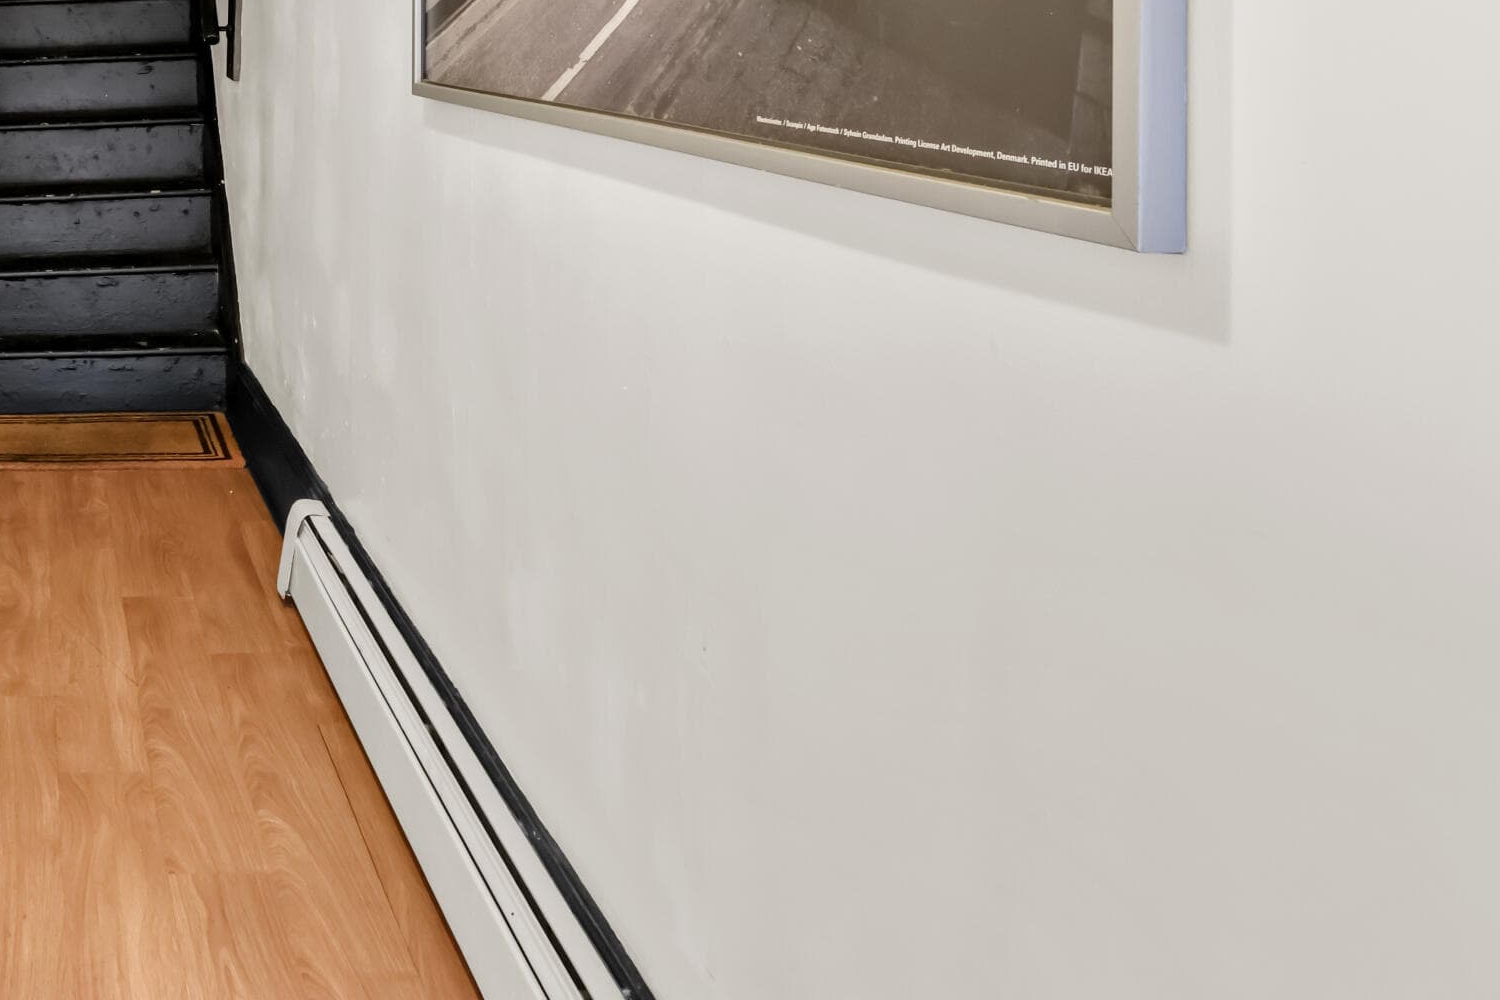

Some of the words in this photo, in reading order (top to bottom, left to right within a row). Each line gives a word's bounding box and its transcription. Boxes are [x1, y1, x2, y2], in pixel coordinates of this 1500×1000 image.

[894, 136, 917, 148] Printing
[917, 139, 940, 150] License
[940, 143, 951, 152] Art
[951, 145, 996, 160] Development,
[1031, 156, 1058, 168] Printed
[1058, 160, 1067, 169] in
[1067, 161, 1080, 171] EU
[1080, 164, 1093, 174] for
